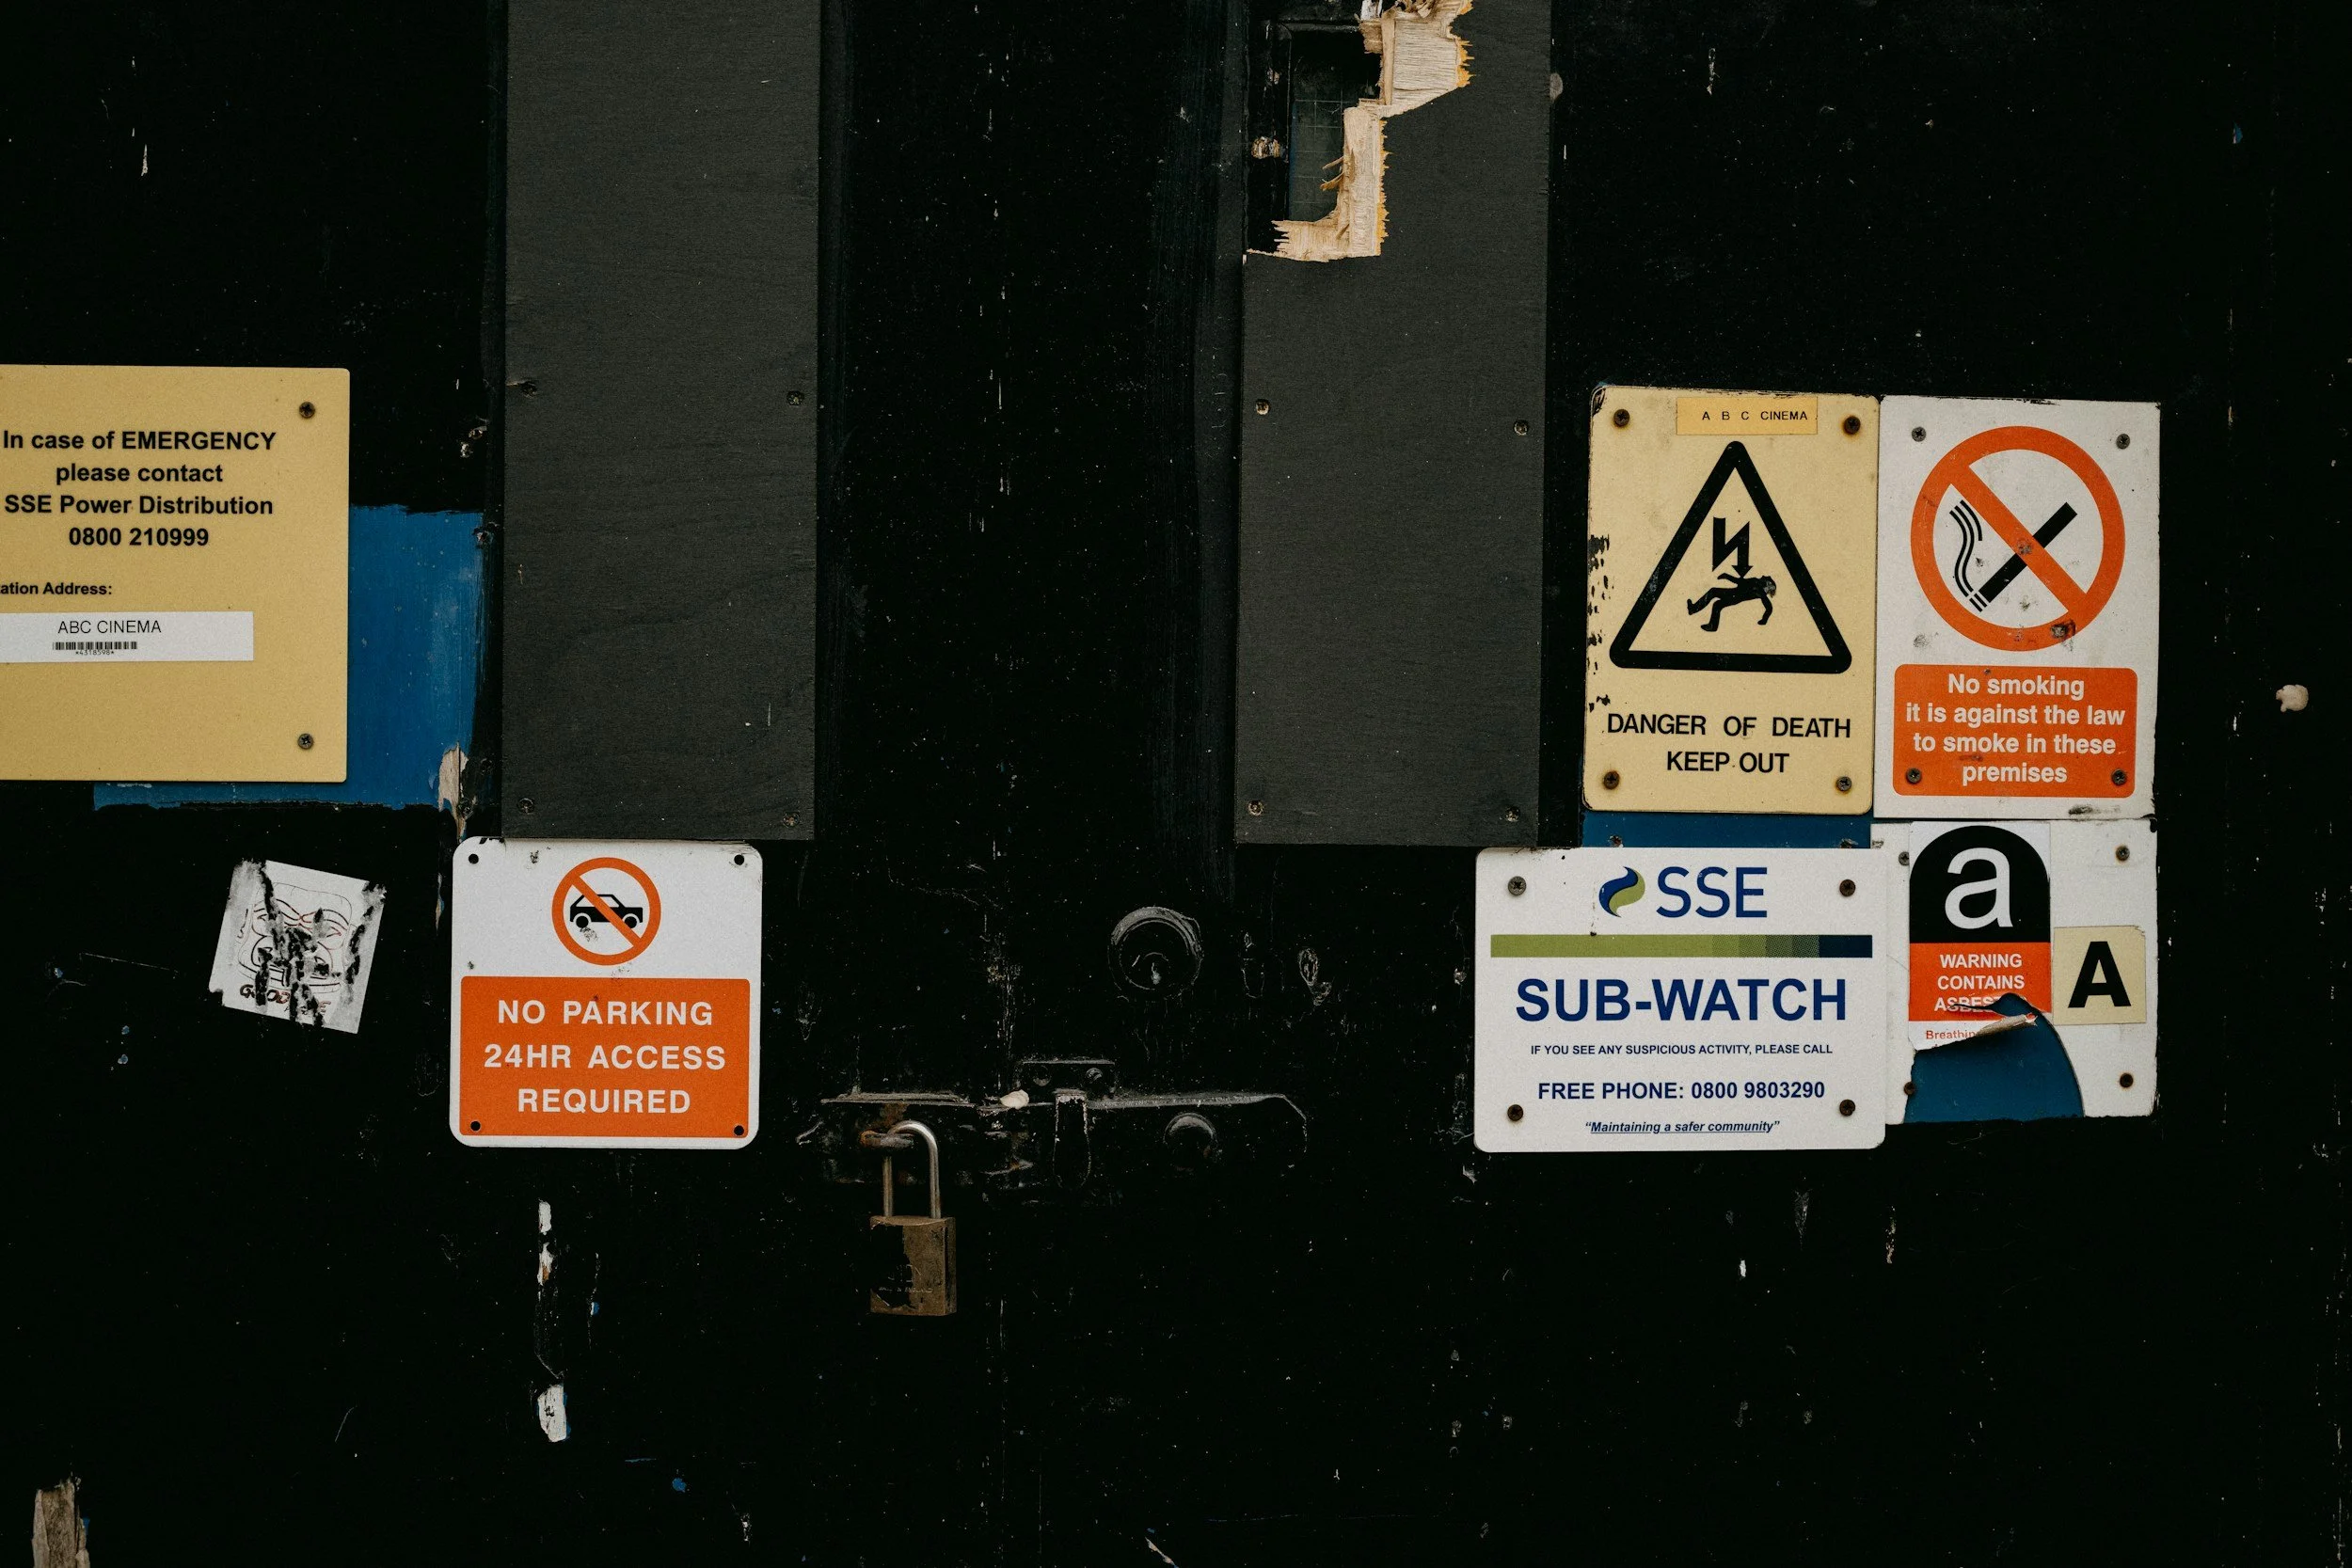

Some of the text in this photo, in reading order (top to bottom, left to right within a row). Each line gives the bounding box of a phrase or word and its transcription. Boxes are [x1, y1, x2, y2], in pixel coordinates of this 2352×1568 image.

[1741, 411, 1749, 420] C
[1761, 411, 1807, 420] CINEMA
[4, 431, 276, 450] In case of EMERGENCY
[56, 463, 222, 485] please contact
[5, 495, 272, 514] SSE Power Distribution
[70, 528, 208, 546] 0800 210999
[0, 582, 112, 594] ation Address:
[58, 621, 161, 633] ABC CINEMA
[1948, 673, 2084, 701] No smoking
[1608, 714, 1850, 737] DANGER OF DEATH
[1907, 703, 2125, 728] it is against the law
[1914, 733, 2115, 754] to smoke in these
[1667, 752, 1789, 773] KEEP OUT
[1963, 763, 2068, 786] premises
[1657, 866, 1767, 918] SSE
[1946, 847, 2012, 928] a
[1940, 954, 2022, 968] WARNING
[1938, 975, 2025, 990] CONTAINS
[2068, 942, 2131, 1007] A
[1517, 978, 1845, 1022] SUB-WATCH
[499, 1000, 711, 1025] NO PARKING
[1926, 1030, 1977, 1039] Breathin
[485, 1044, 724, 1069] 24HR ACCESS
[1532, 1046, 1540, 1054] IF
[1545, 1046, 1568, 1054] YOU
[1573, 1046, 1595, 1054] SEE
[1627, 1045, 1695, 1053] SUSPICIOUS
[1699, 1045, 1752, 1055] ACTIVITY,
[1756, 1045, 1800, 1054] PLEASE
[1803, 1045, 1833, 1054] CALL
[518, 1089, 690, 1113] REQUIRED
[1539, 1082, 1824, 1099] FREE PHONE: 0800 9803290
[1663, 1123, 1672, 1132] a
[1675, 1122, 1704, 1132] safer
